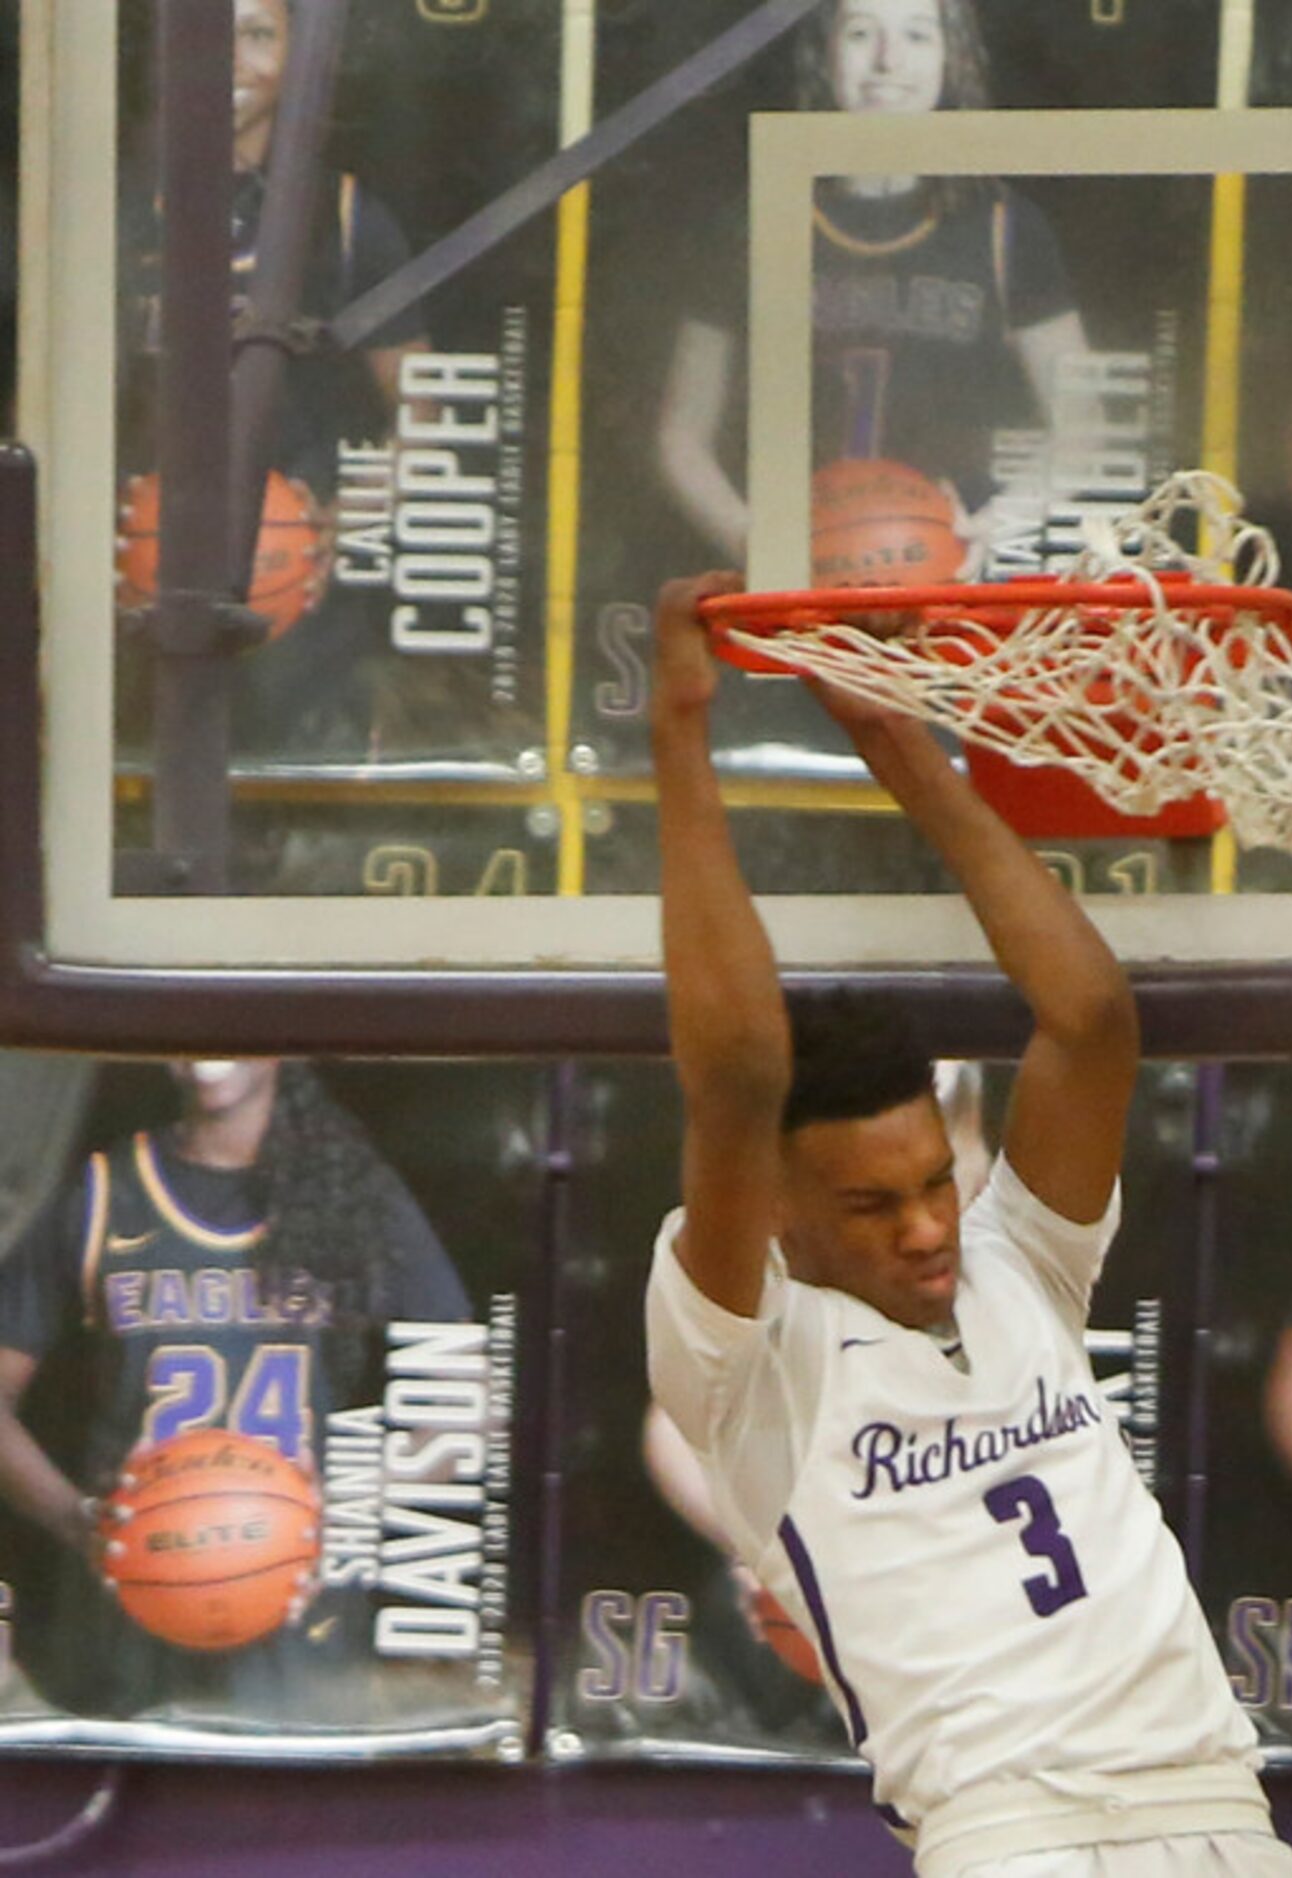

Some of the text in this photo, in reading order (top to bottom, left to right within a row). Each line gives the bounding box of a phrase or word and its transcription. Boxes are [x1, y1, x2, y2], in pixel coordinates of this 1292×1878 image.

[336, 438, 394, 584] CALLIE
[392, 352, 499, 652] COOPER
[142, 1342, 312, 1463] 24
[321, 1405, 383, 1584] SHANIA
[375, 1322, 488, 1655] DAVISON
[982, 1474, 1091, 1617] 3
[577, 1590, 689, 1701] SG
